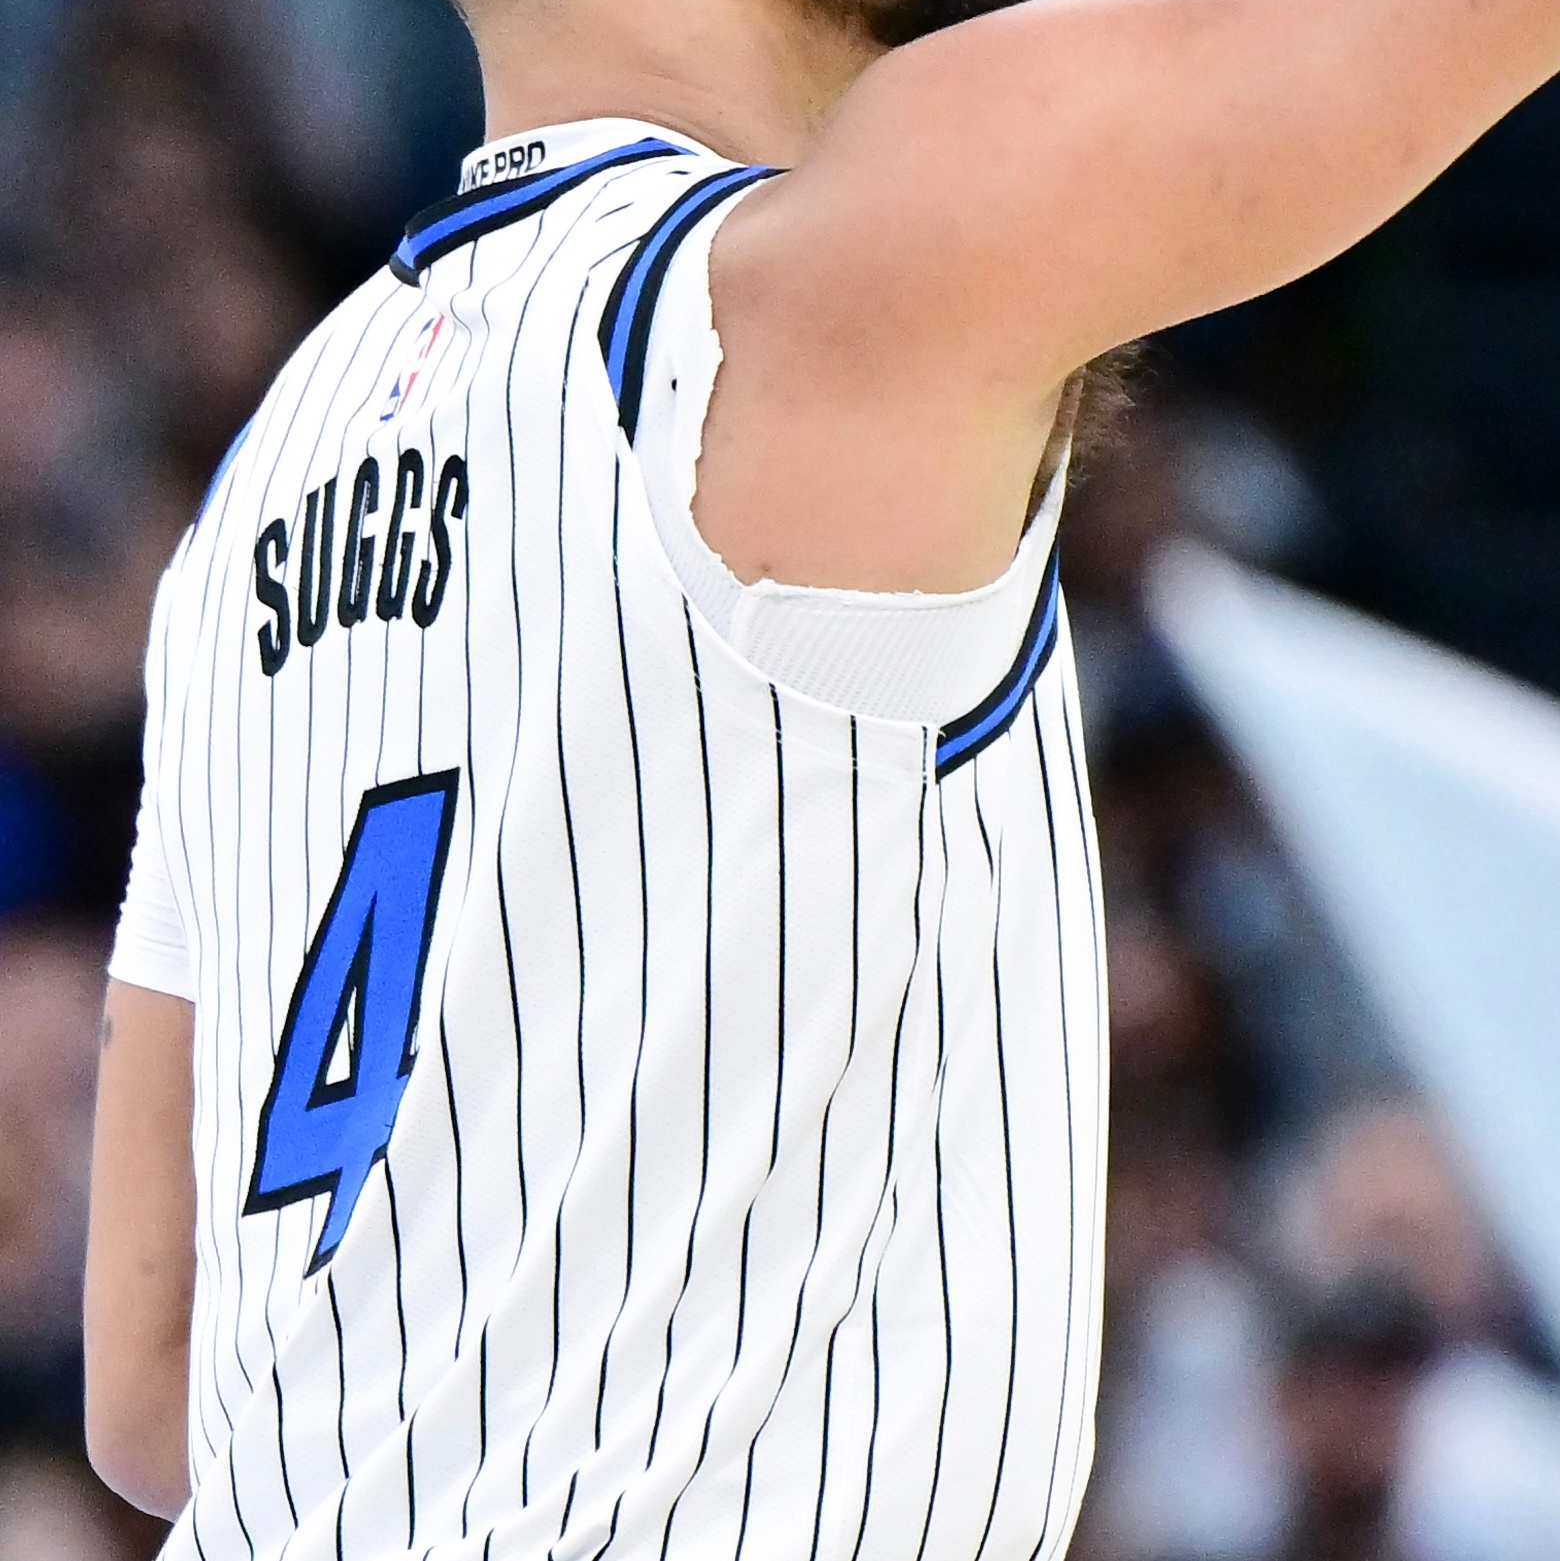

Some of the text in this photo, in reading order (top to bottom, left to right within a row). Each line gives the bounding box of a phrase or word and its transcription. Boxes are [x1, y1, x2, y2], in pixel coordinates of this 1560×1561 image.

[492, 140, 546, 182] PRO
[254, 448, 469, 676] SUGGS
[242, 767, 460, 1279] 4
